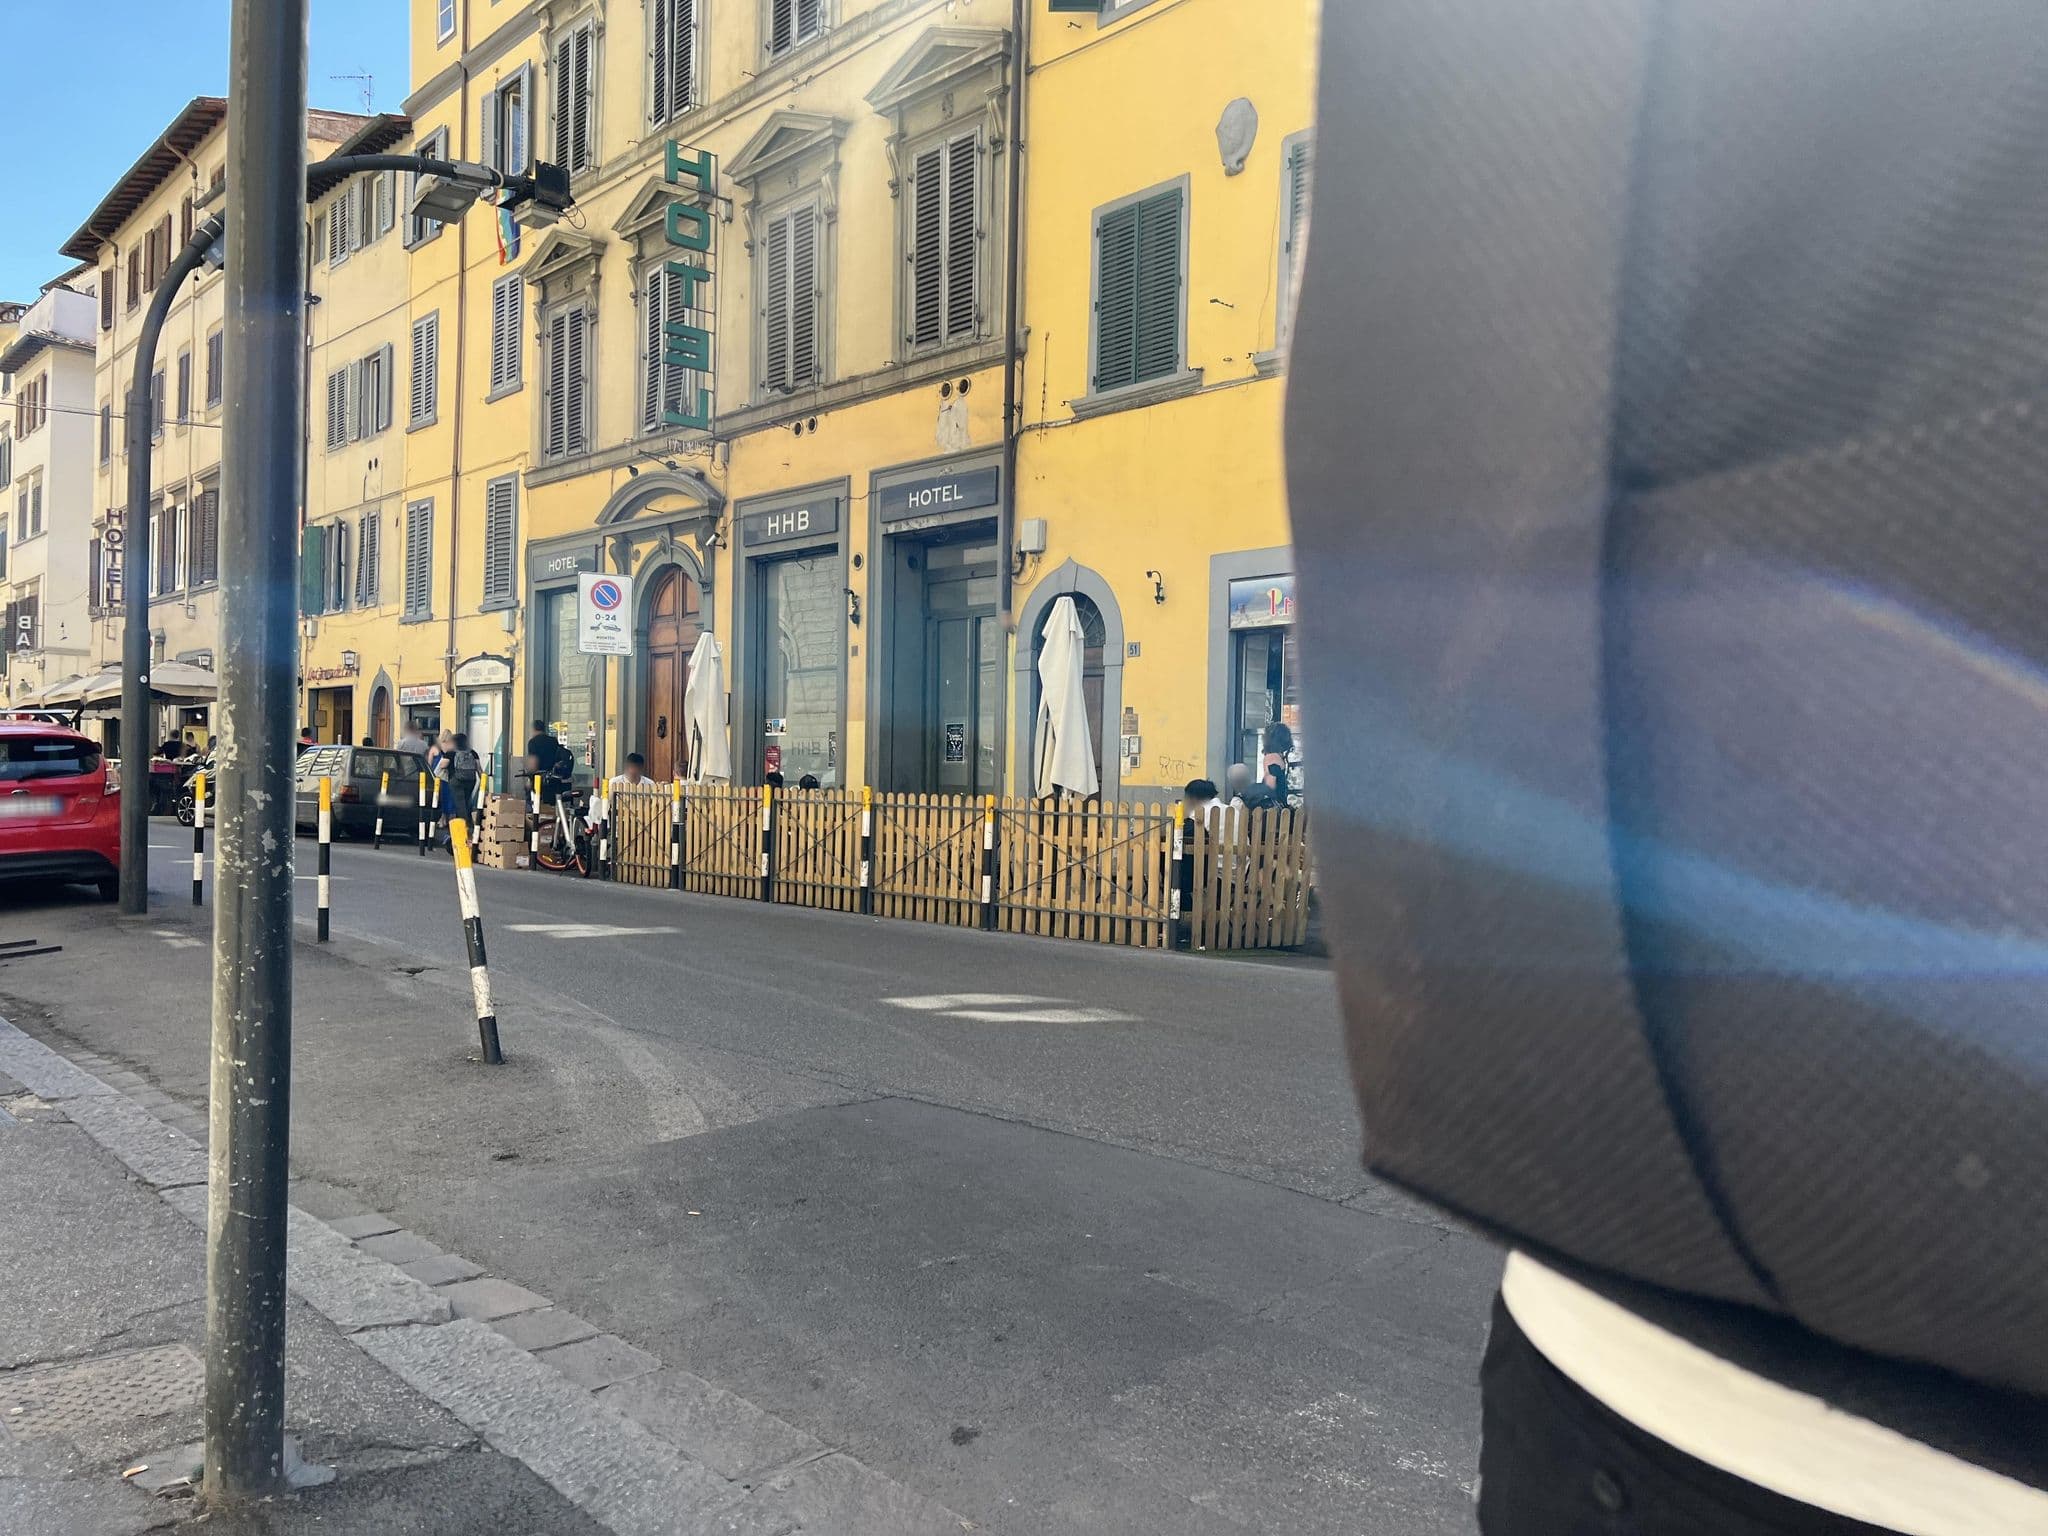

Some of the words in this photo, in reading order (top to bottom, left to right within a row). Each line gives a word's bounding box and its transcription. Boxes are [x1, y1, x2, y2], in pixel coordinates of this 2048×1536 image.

[909, 484, 963, 508] HOTEL
[767, 510, 809, 537] HHB
[105, 508, 123, 603] HOTEL
[548, 556, 578, 572] HOTEL
[595, 613, 617, 621] 0-24
[1129, 645, 1138, 655] 51
